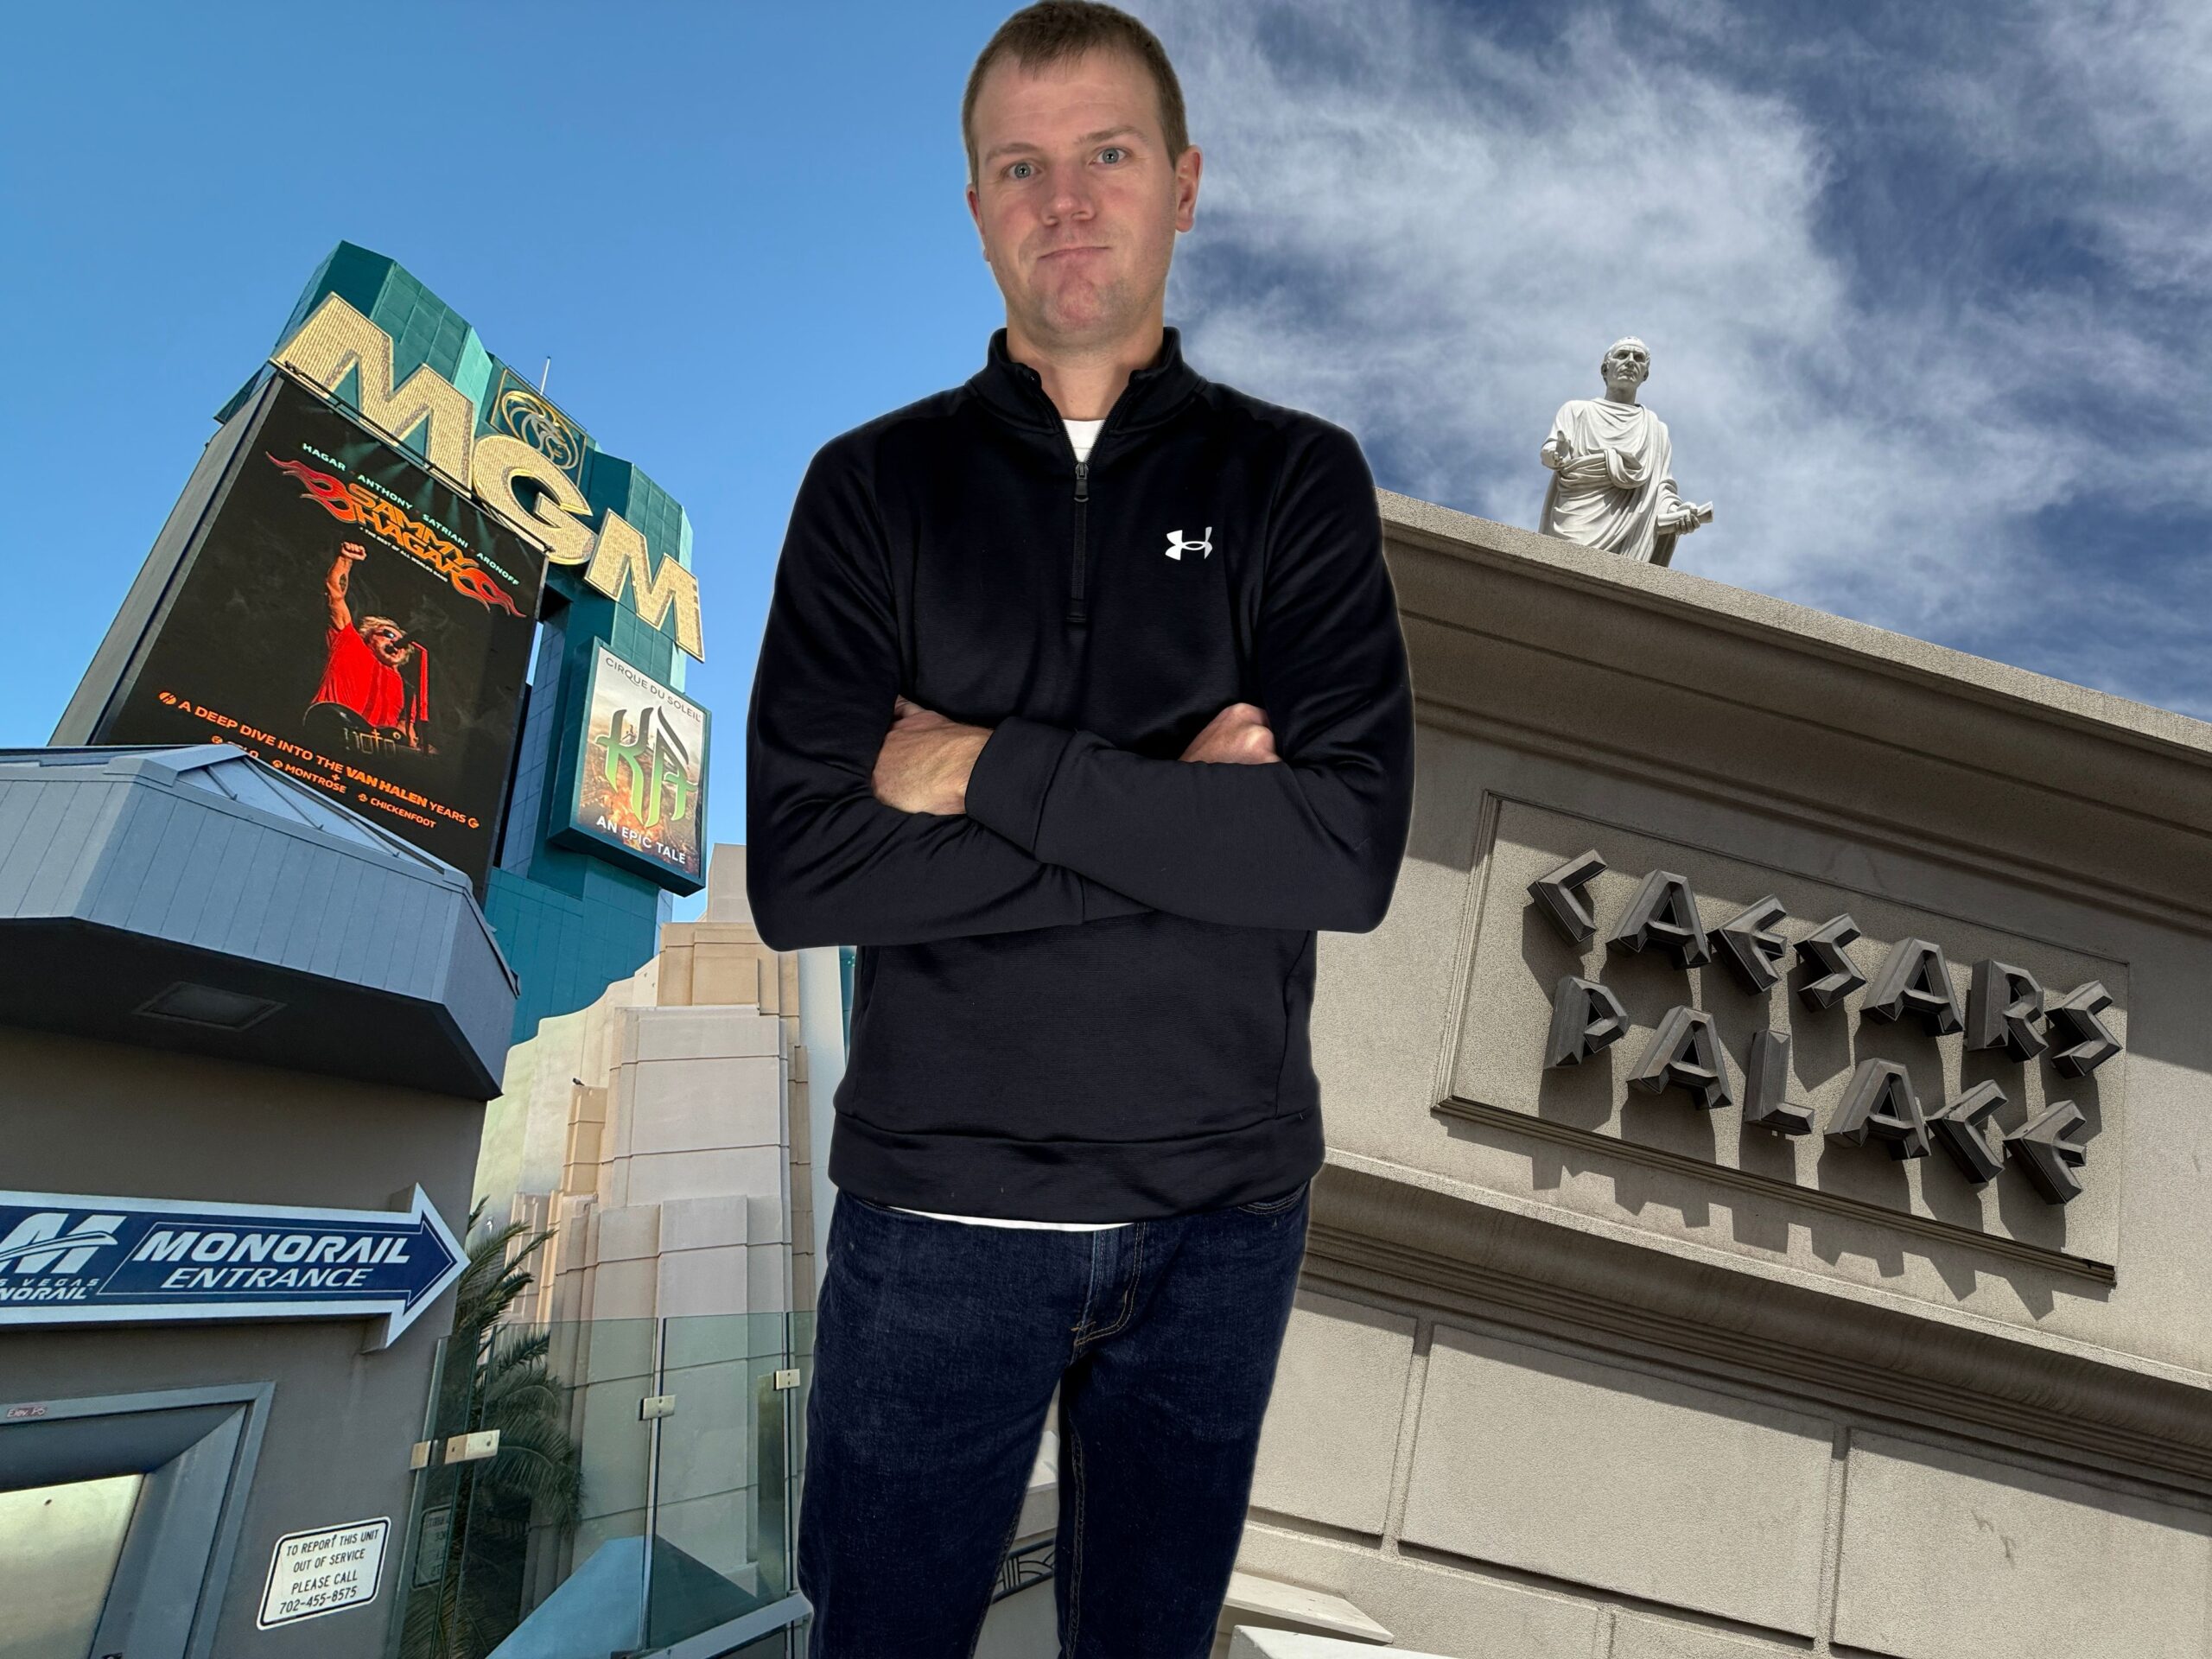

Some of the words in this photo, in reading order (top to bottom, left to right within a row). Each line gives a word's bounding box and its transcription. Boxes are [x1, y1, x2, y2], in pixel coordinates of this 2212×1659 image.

[270, 291, 704, 663] MGM
[302, 442, 346, 472] HAGAR
[357, 474, 413, 511] ANTHONY
[422, 513, 468, 549] SATRIANI
[476, 552, 520, 587] ARONOFF
[347, 482, 480, 568] SAMMY
[353, 499, 468, 575] HAGAR
[400, 550, 411, 559] ALL
[606, 657, 648, 690] CIRQUE
[650, 684, 665, 699] DU
[667, 696, 701, 722] SOLEIL
[178, 701, 192, 713] A
[194, 706, 238, 728] DEEP
[239, 724, 276, 747] DIVE
[276, 740, 314, 761] INTO
[316, 754, 344, 774] THE
[346, 766, 378, 788] VAN
[378, 780, 429, 808] HALEN
[429, 801, 467, 823] YEARS
[285, 763, 346, 795] MONTROSE
[370, 798, 437, 830] CHICKENFOOT
[596, 815, 618, 834] AN
[621, 826, 652, 849] EPIC
[656, 842, 686, 864] TALE
[1528, 848, 2123, 1077] CAESARS
[1544, 976, 2087, 1205] PALACE
[131, 1230, 410, 1264] MONORAIL
[22, 1278, 100, 1287] VEGAS
[161, 1267, 374, 1289] ENTRANCE
[286, 1545, 298, 1556] TO
[301, 1536, 336, 1554] REPORT
[340, 1534, 358, 1545] THIS
[360, 1529, 379, 1541] UNIT
[293, 1560, 312, 1573] OUT
[314, 1556, 327, 1567] OF
[329, 1548, 365, 1565] SERVICE
[291, 1575, 331, 1595] PLEASE
[334, 1569, 358, 1586] CALL
[279, 1586, 358, 1614] 702-455-8575
